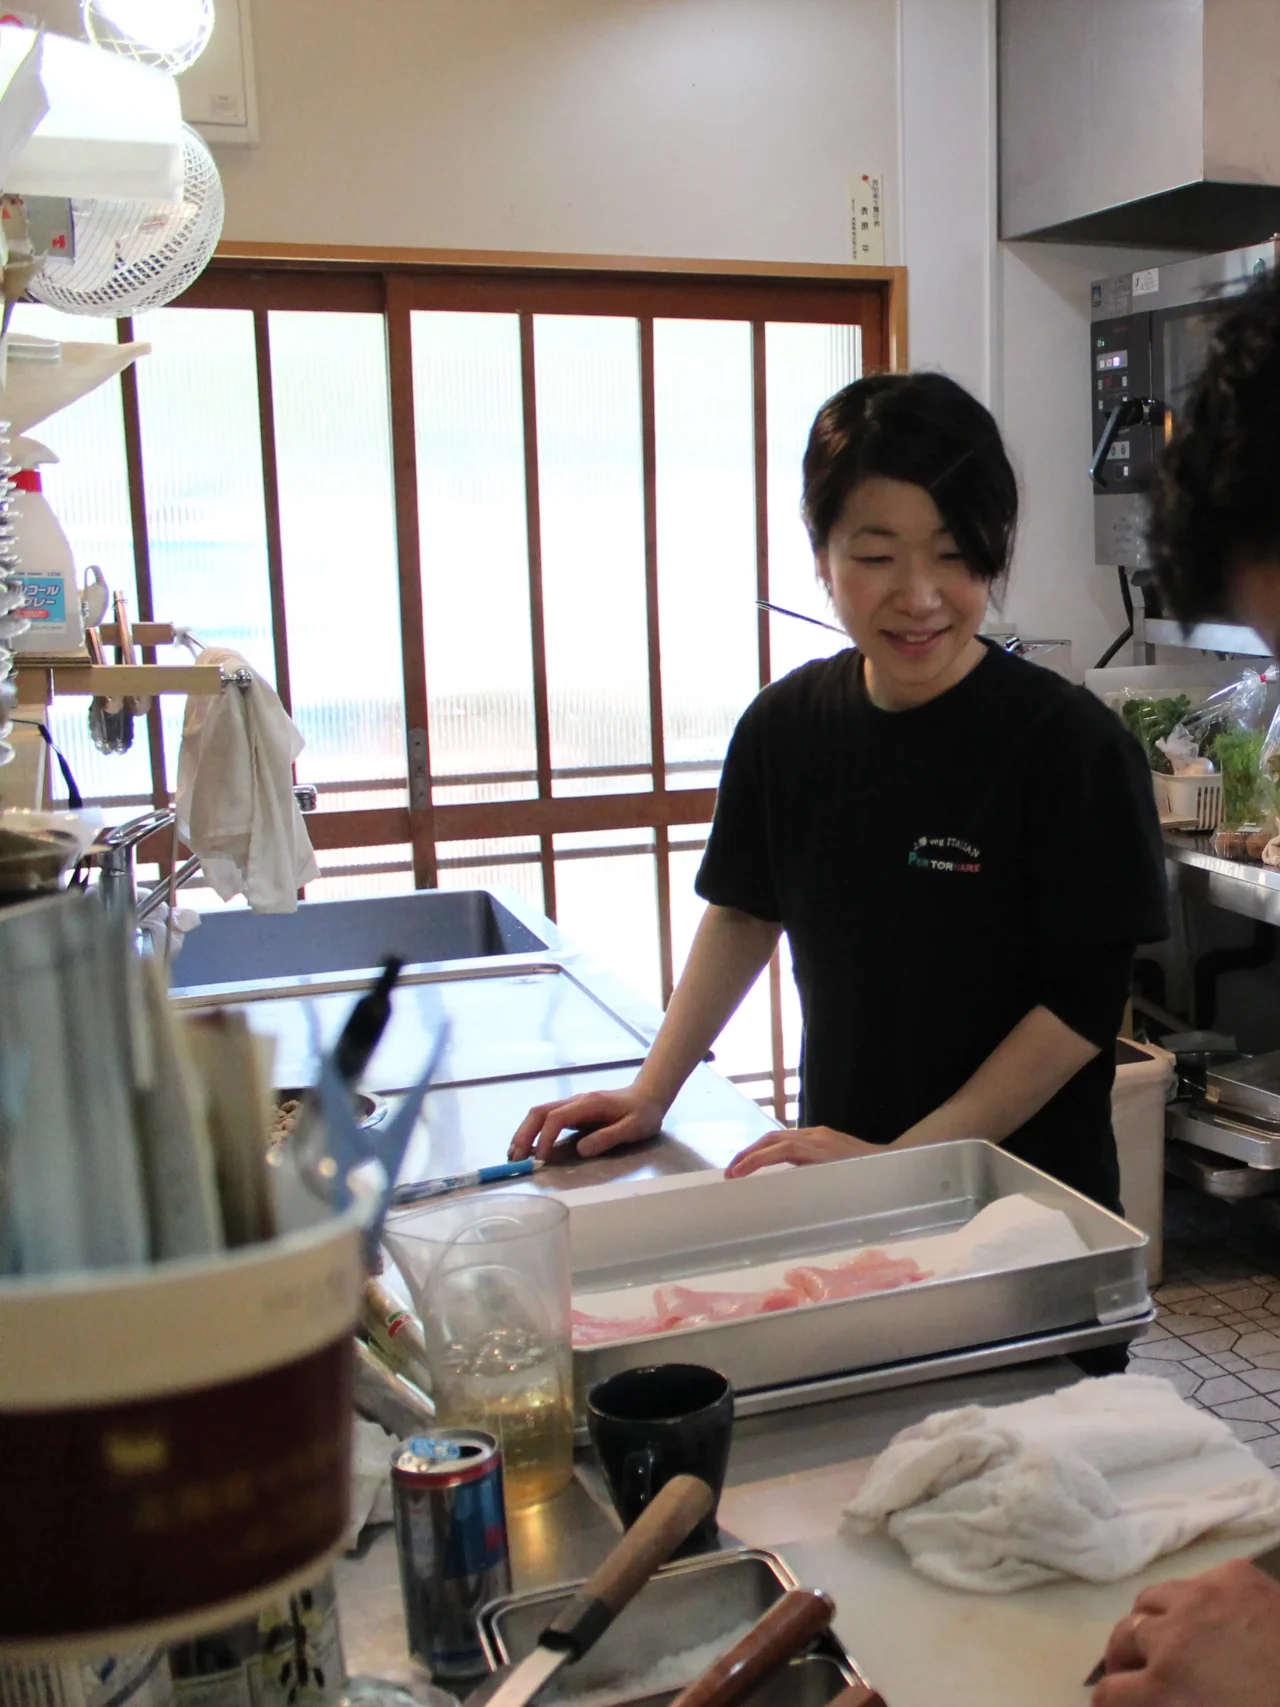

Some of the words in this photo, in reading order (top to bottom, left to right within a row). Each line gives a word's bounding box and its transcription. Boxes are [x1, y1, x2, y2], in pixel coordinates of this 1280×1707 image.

[16, 584, 60, 596] ルコール
[929, 838, 945, 847] veg
[946, 837, 980, 858] ITALIAN
